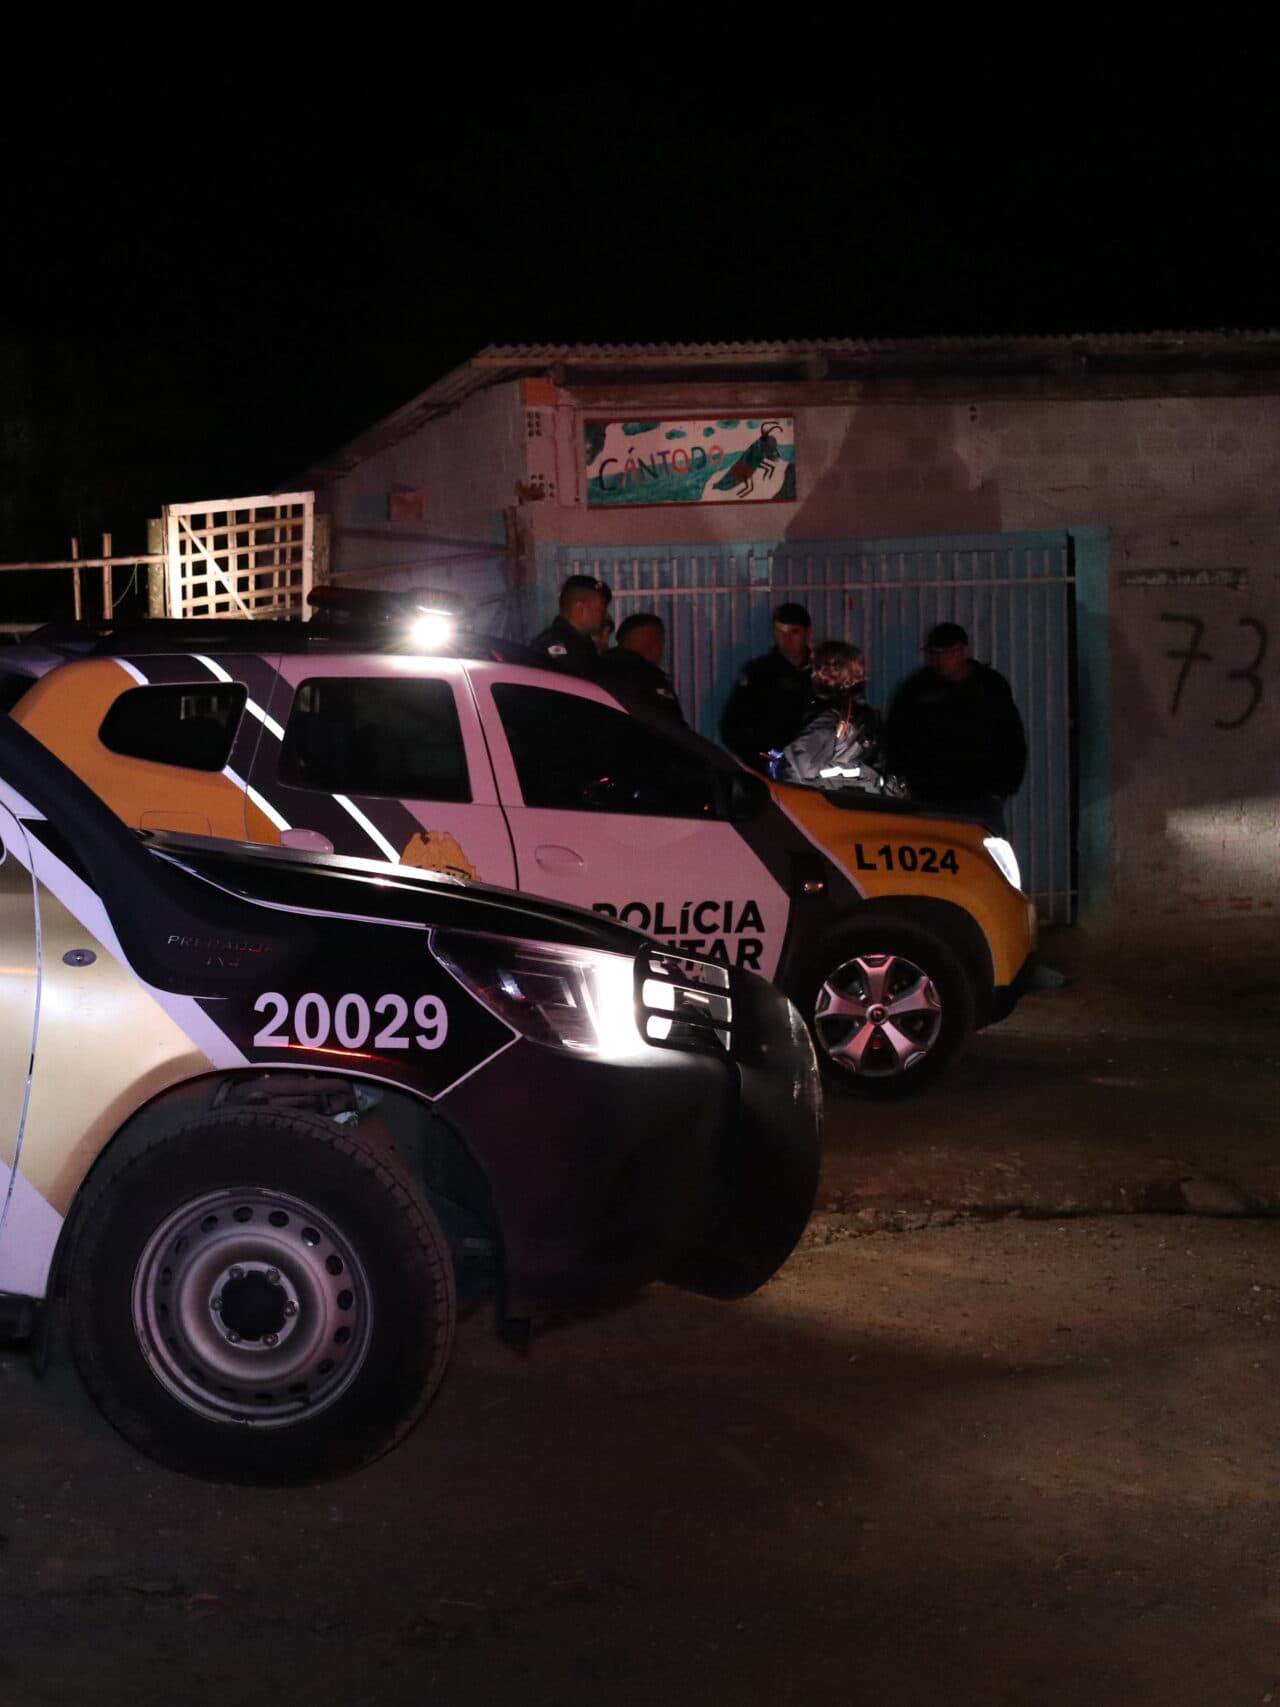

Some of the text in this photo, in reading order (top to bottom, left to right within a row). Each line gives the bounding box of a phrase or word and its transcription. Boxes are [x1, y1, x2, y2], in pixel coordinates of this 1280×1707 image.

[1160, 612, 1268, 731] 73
[855, 843, 960, 875] L1024
[253, 991, 449, 1050] 20029
